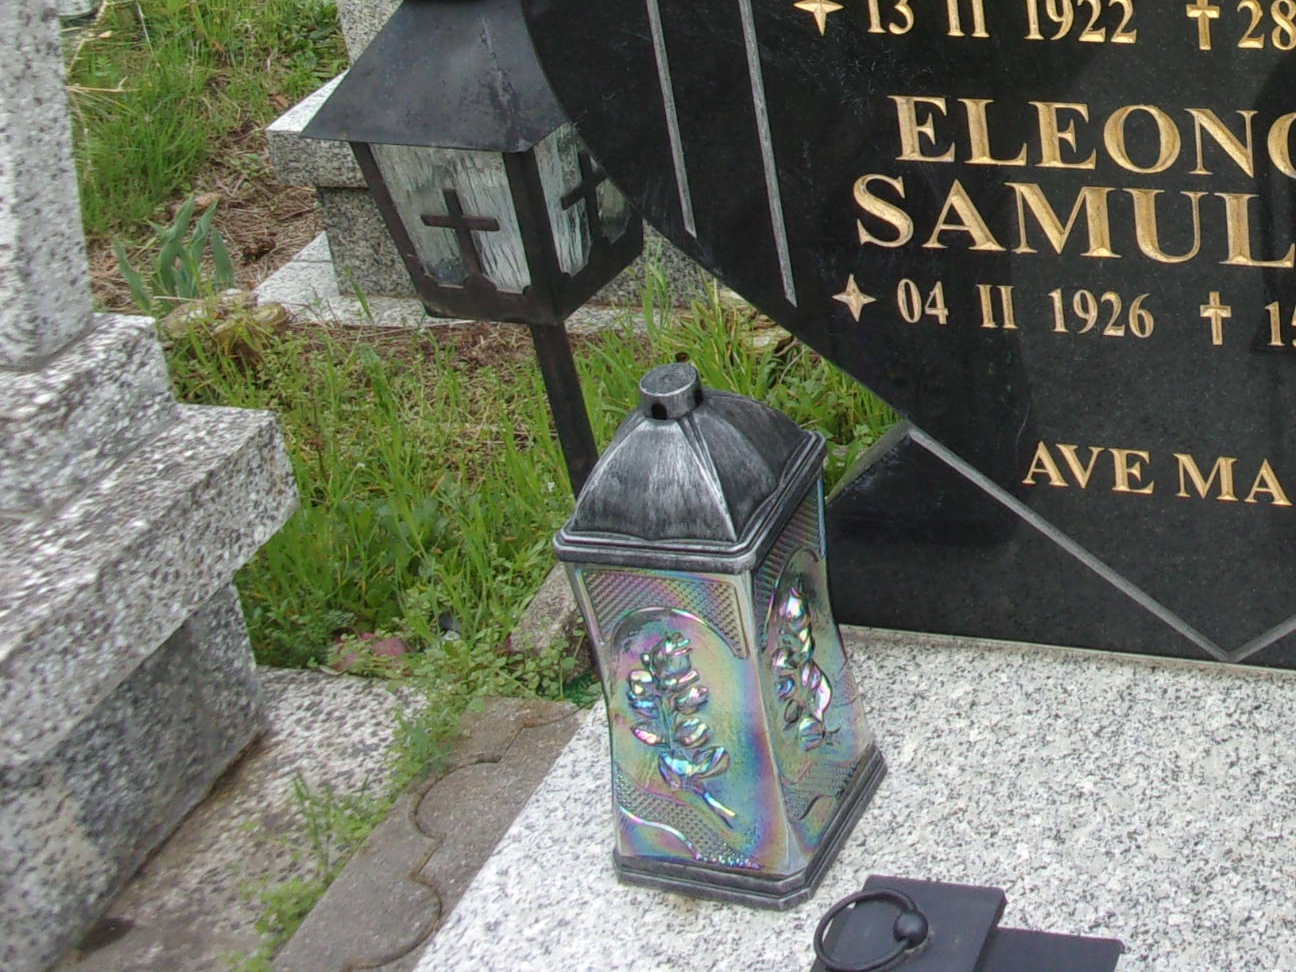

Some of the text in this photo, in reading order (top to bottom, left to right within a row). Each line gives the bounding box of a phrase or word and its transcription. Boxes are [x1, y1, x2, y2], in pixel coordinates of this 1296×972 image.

[896, 278, 949, 325] 04
[976, 284, 1018, 330] II
[1048, 288, 1155, 339] 1926
[1022, 440, 1155, 495] AVE
